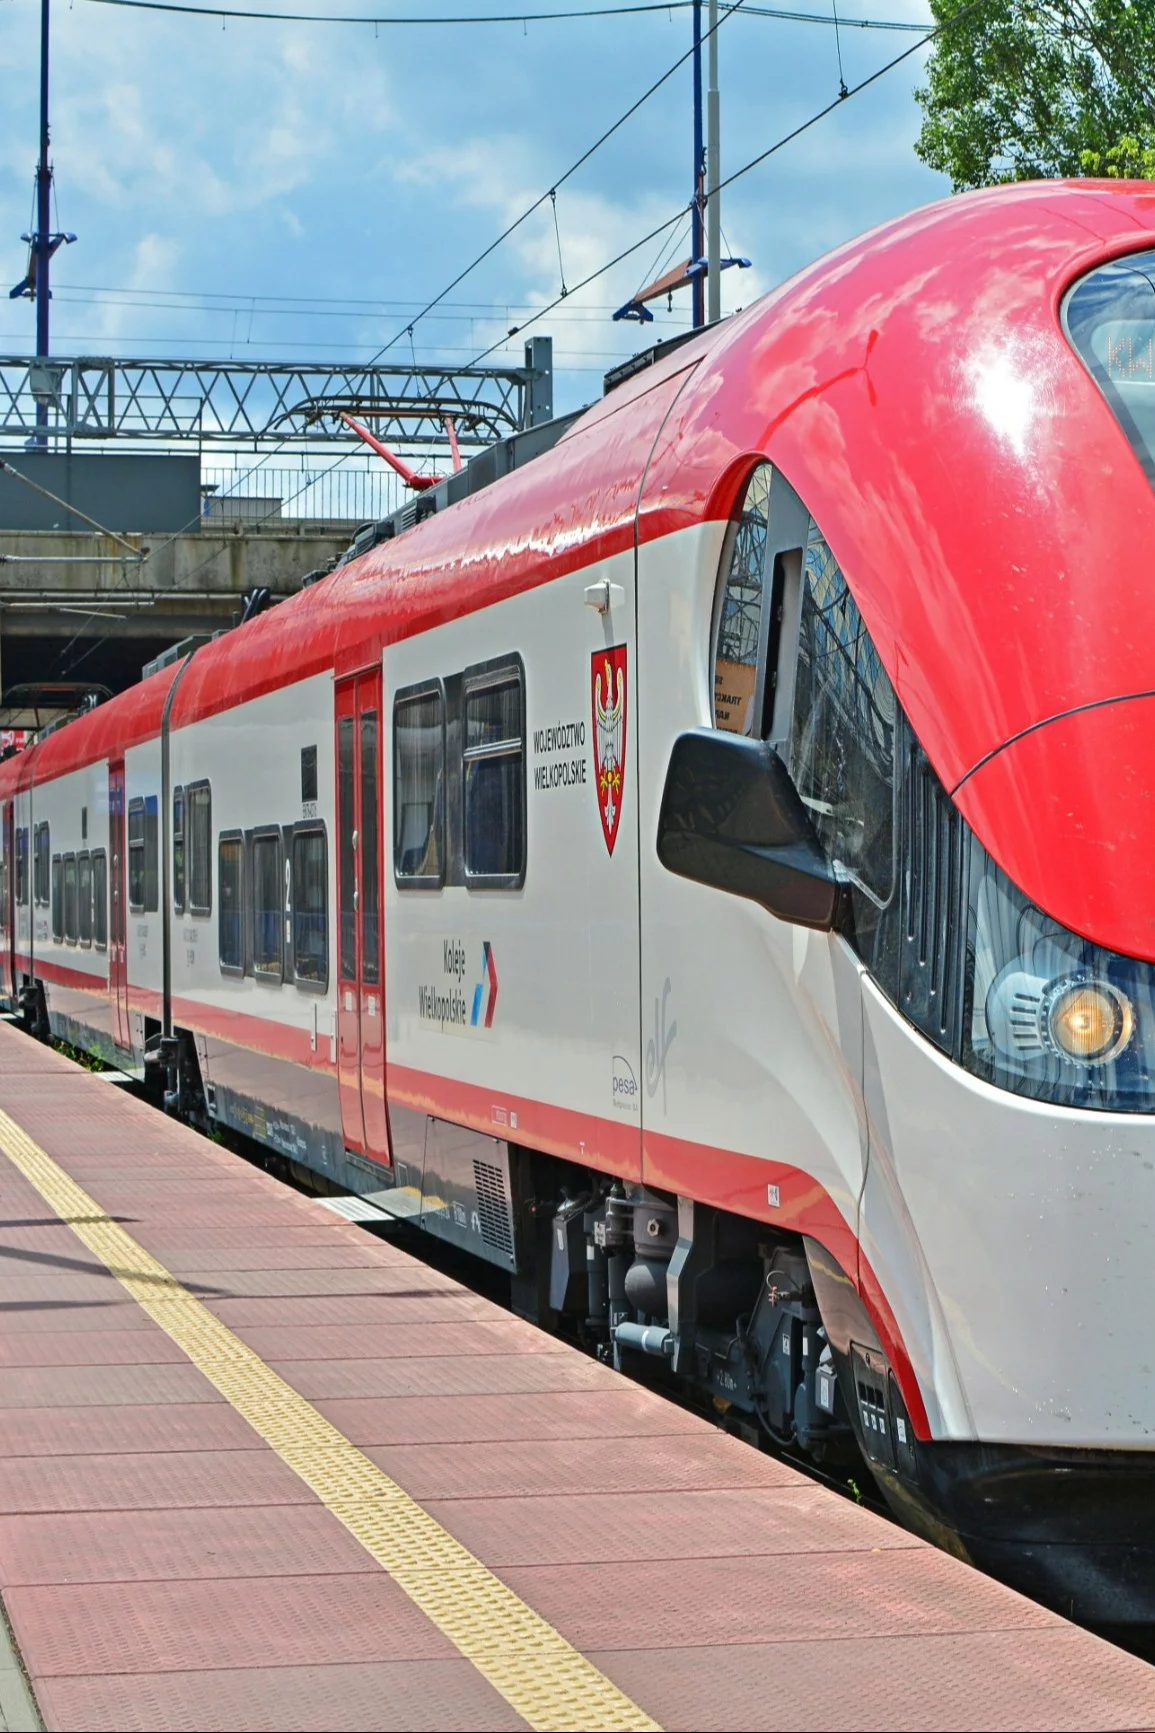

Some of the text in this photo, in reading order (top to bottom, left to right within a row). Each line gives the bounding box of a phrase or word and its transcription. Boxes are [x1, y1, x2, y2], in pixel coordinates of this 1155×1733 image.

[533, 720, 586, 754] WOJEWÓDZTWO
[533, 759, 587, 791] WIELKOPOLSKIE
[443, 939, 466, 983] Koleje
[418, 985, 467, 1033] Wielkopolskie
